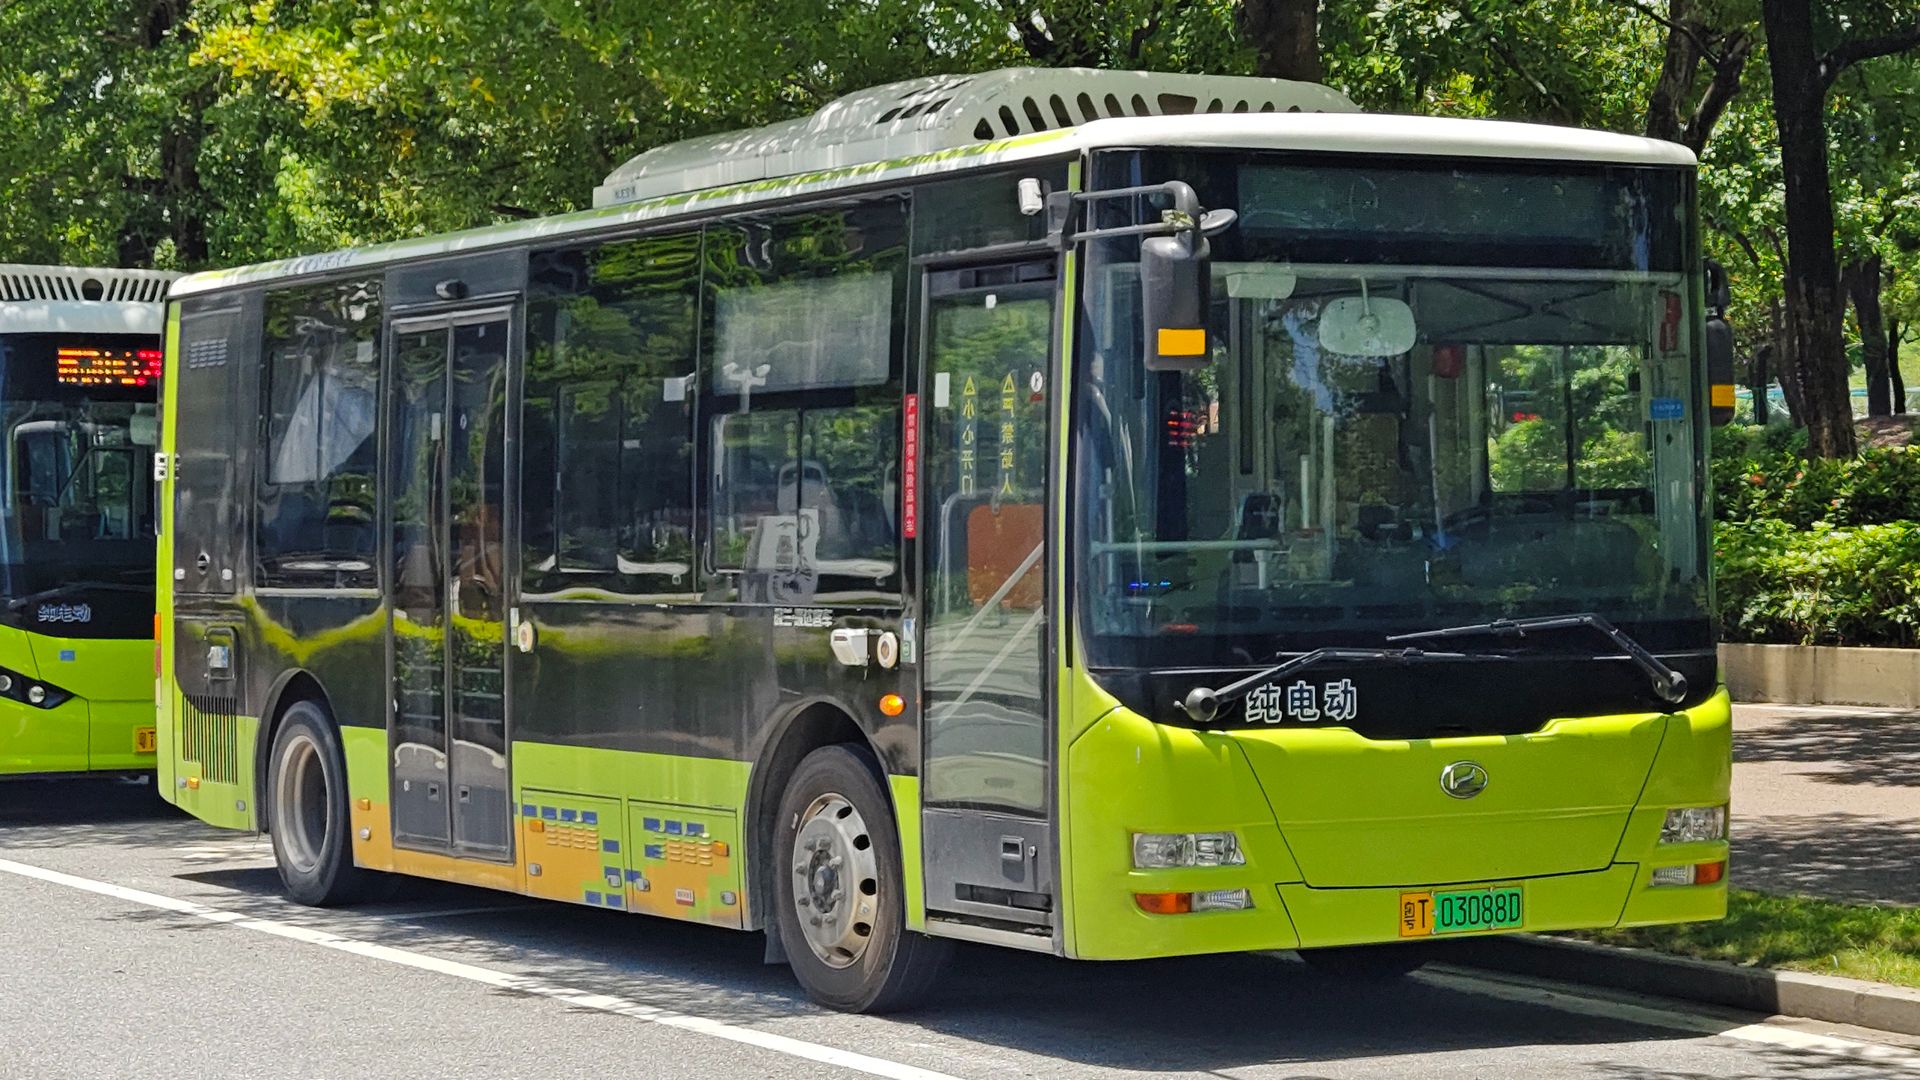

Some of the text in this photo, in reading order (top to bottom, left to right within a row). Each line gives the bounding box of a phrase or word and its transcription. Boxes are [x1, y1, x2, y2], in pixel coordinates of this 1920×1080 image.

[1245, 678, 1357, 724] 纯电动
[1404, 892, 1521, 930] 粤T 03088D
